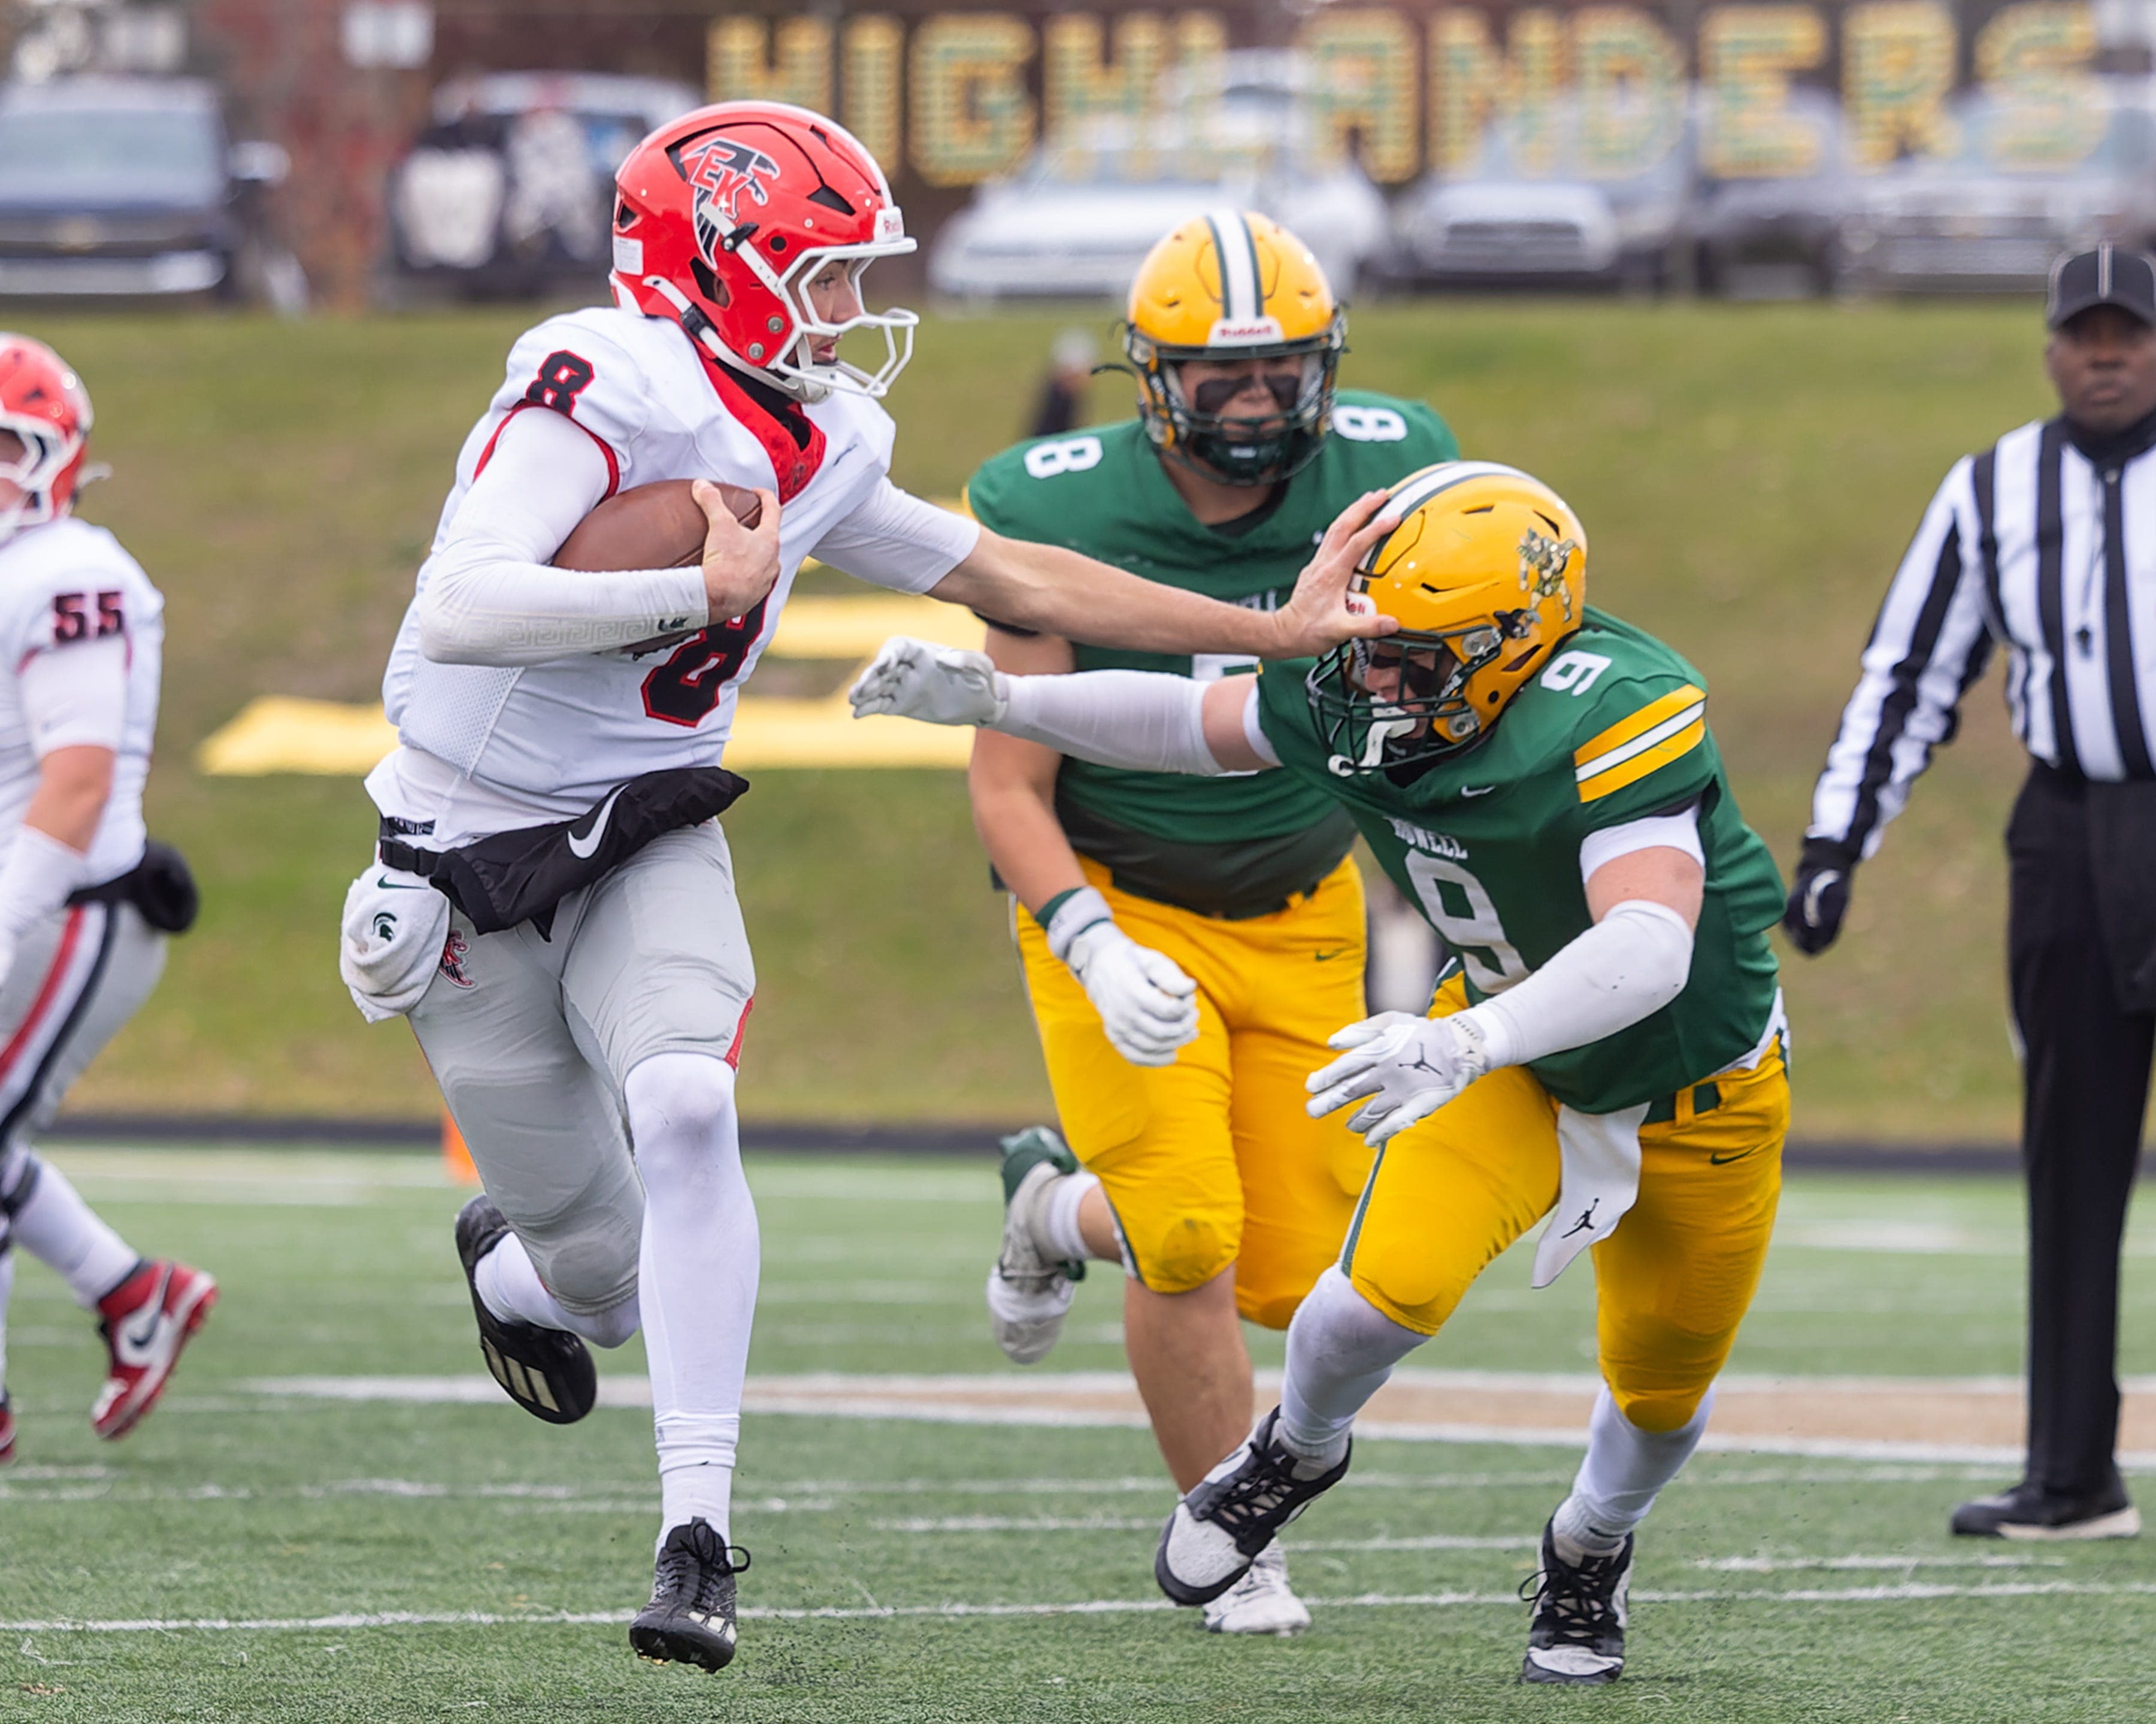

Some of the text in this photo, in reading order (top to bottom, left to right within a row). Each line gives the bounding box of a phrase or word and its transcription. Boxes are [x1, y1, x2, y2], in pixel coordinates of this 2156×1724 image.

[705, 5, 2107, 188] HIGHLANDERS
[689, 145, 752, 220] EK
[526, 350, 594, 417] 8
[1024, 437, 1103, 478] 8
[1333, 405, 1408, 443] 8
[55, 592, 123, 643] 55
[640, 577, 779, 729] 8
[1540, 650, 1613, 696] 9
[1404, 849, 1532, 995] 9
